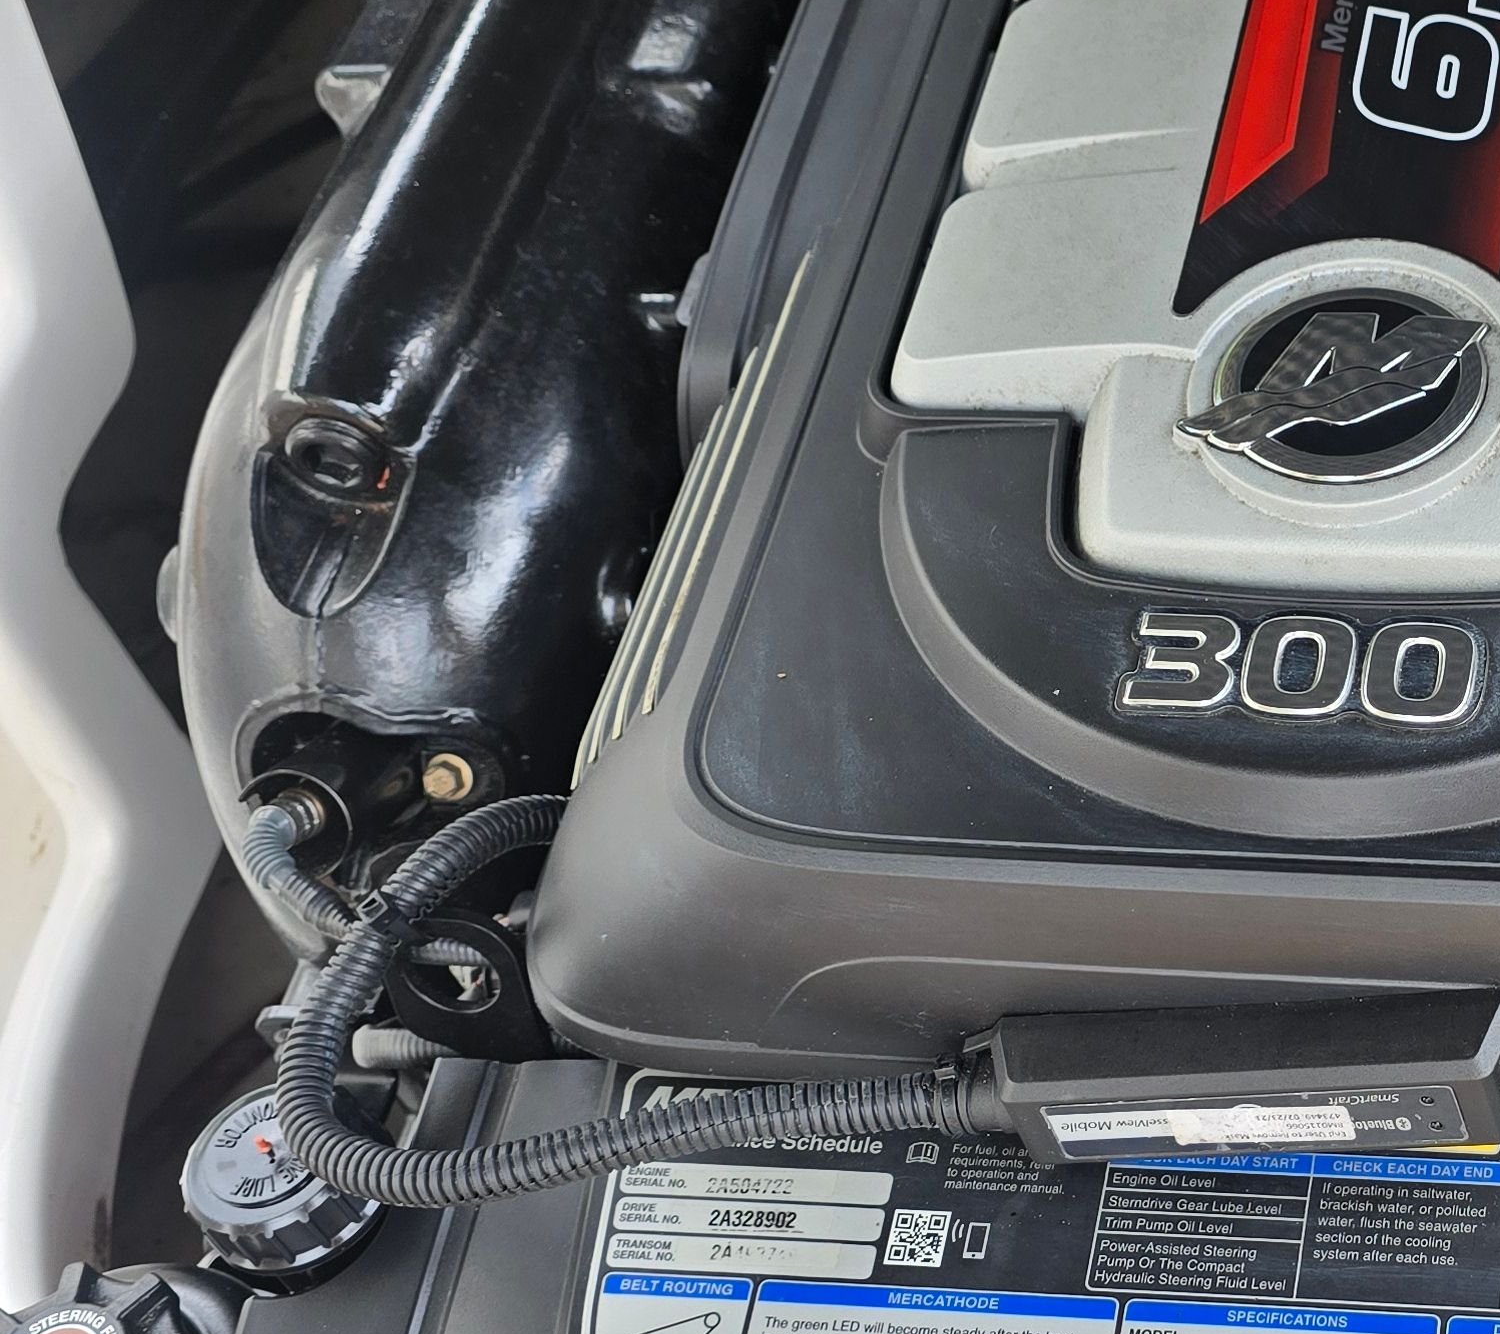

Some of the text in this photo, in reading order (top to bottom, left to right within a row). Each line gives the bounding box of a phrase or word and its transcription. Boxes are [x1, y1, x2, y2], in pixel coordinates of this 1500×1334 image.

[1120, 609, 1485, 724] 300
[1327, 1093, 1401, 1106] SmartCraft
[1060, 1120, 1113, 1133] Mobile
[780, 1133, 884, 1155] Schedule
[626, 1165, 672, 1178] ENGINE
[1220, 1156, 1249, 1167] DAY
[1252, 1156, 1299, 1169] START
[1332, 1160, 1494, 1180] CHECK EACH DAY END
[624, 1176, 688, 1189] SERIAL NO.
[1112, 1171, 1217, 1189] Engine Oil Level
[1321, 1181, 1473, 1203] If operating in saltwater,
[621, 1201, 658, 1213] DRIVE
[1107, 1194, 1283, 1216] Sterndrive Gear Lube Level
[1319, 1197, 1488, 1219] brackish water, or polluted
[618, 1212, 682, 1225] SERIAL NO.
[708, 1209, 797, 1230] 2A328902
[615, 1238, 673, 1251] TRANSOM
[1099, 1239, 1258, 1262] Power-Assisted Steering
[611, 1249, 676, 1262] SERIAL NO.
[619, 1277, 734, 1296] BELT ROUTING
[1093, 1269, 1287, 1292] Hydraulic Steering Fluid Level
[887, 1291, 1000, 1310] MERCATHODE
[764, 1315, 789, 1330] The
[790, 1319, 829, 1333] green
[831, 1319, 861, 1333] LED
[863, 1321, 885, 1334] will
[1226, 1309, 1348, 1329] SPECIFICATIONS
